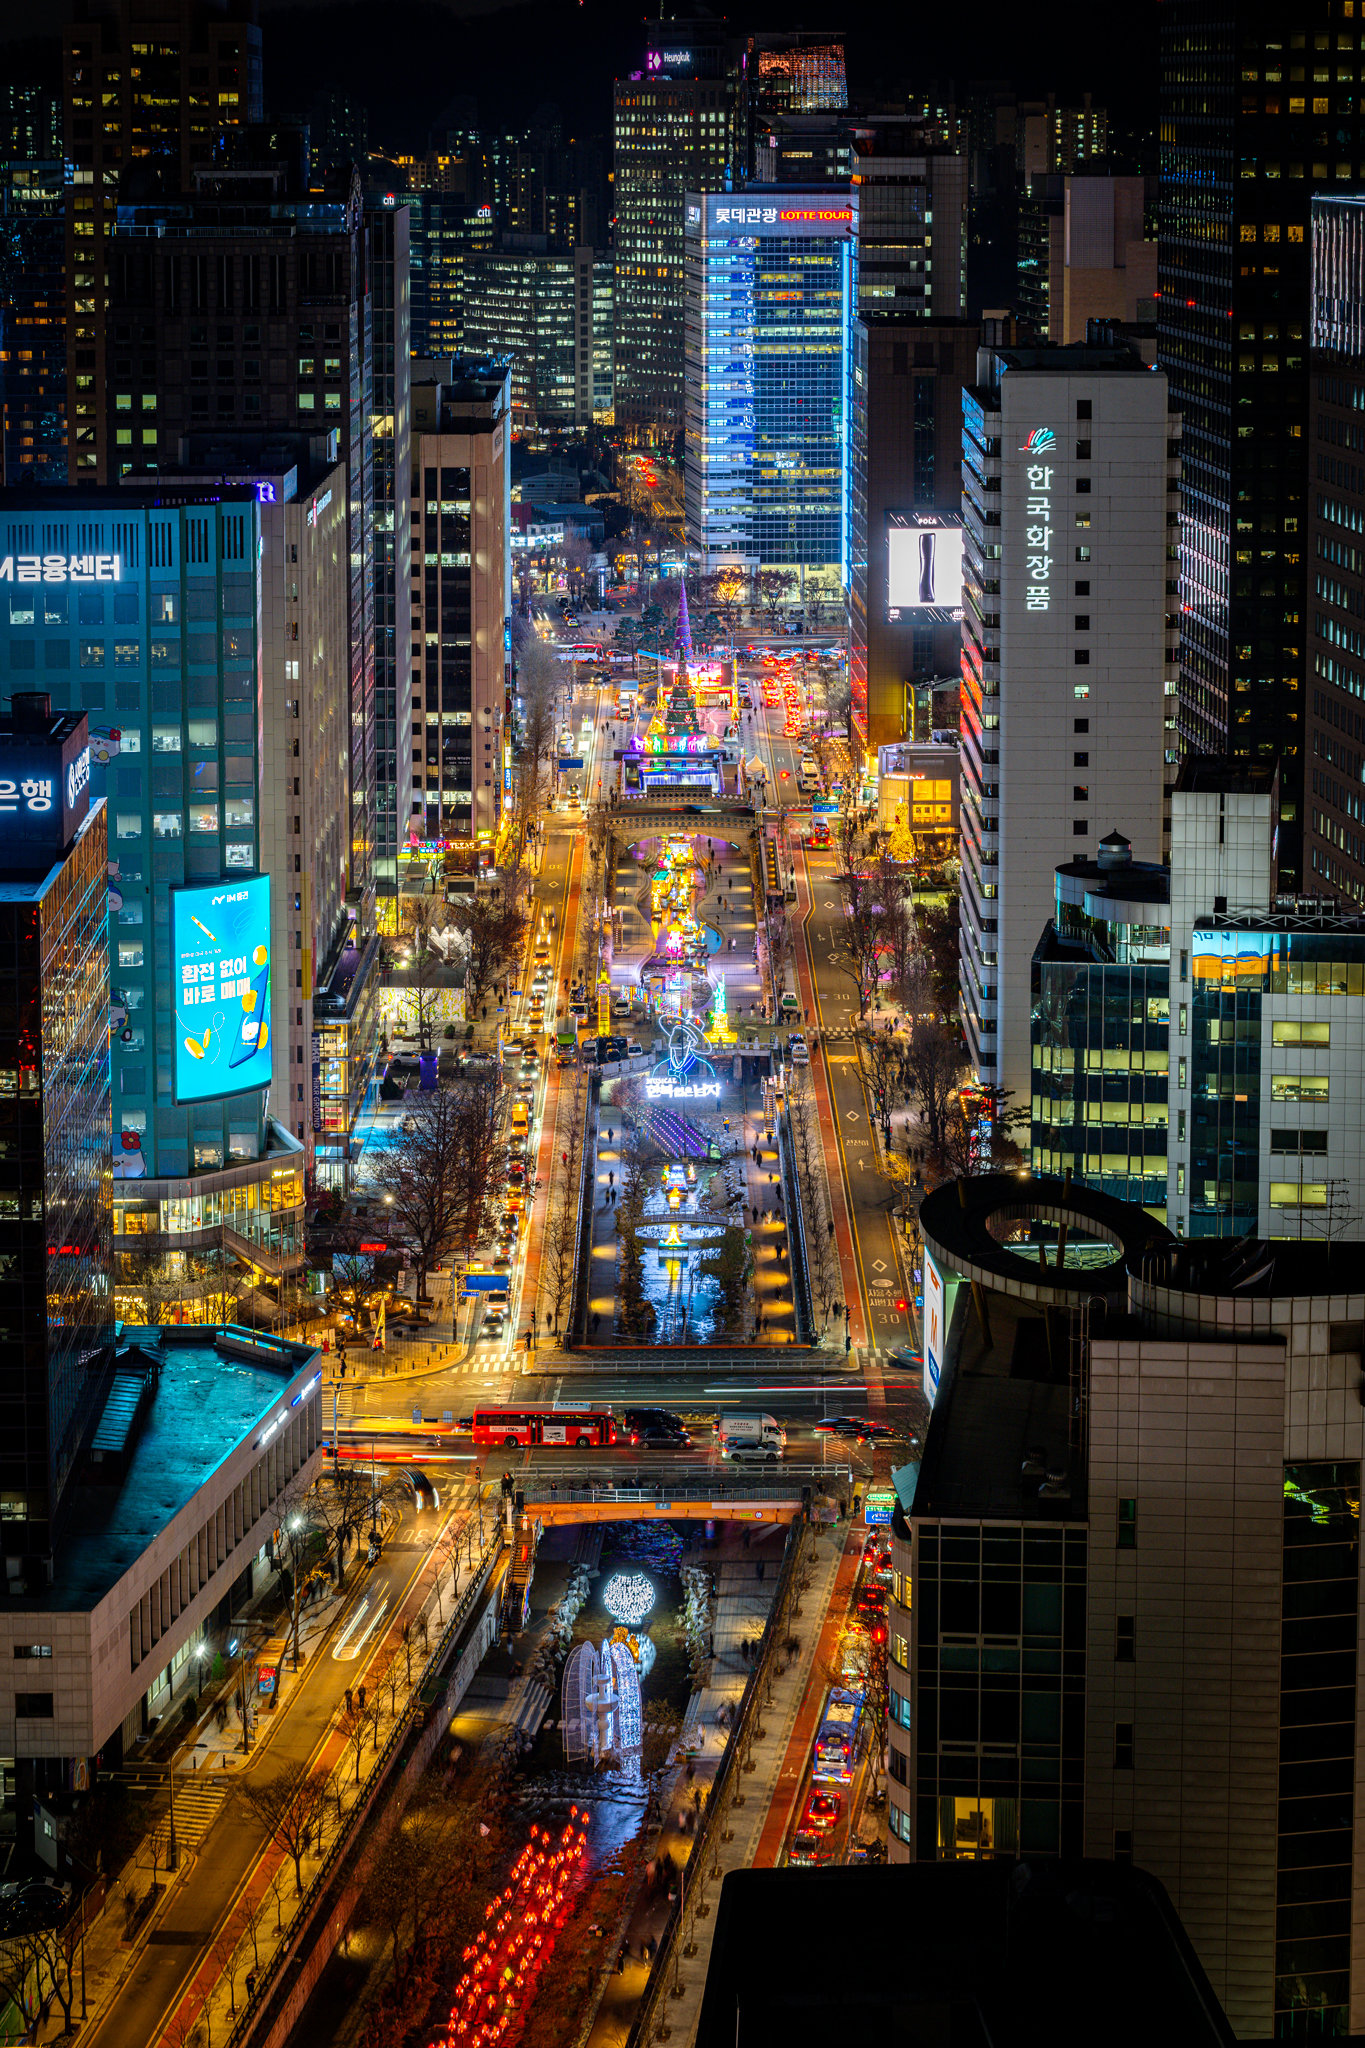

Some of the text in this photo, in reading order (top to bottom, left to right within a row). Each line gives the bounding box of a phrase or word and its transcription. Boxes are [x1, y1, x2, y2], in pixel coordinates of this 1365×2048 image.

[663, 51, 691, 65] Heungkuk
[383, 194, 395, 205] citi
[478, 206, 491, 217] citi
[715, 208, 777, 223] 롯데관광
[781, 211, 816, 220] LOTTE
[817, 211, 850, 220] TOUR
[1026, 465, 1054, 611] 한국화장품
[181, 956, 247, 984] 환전 없이
[183, 976, 251, 1005] 바로 매매
[877, 1313, 900, 1324] 30
